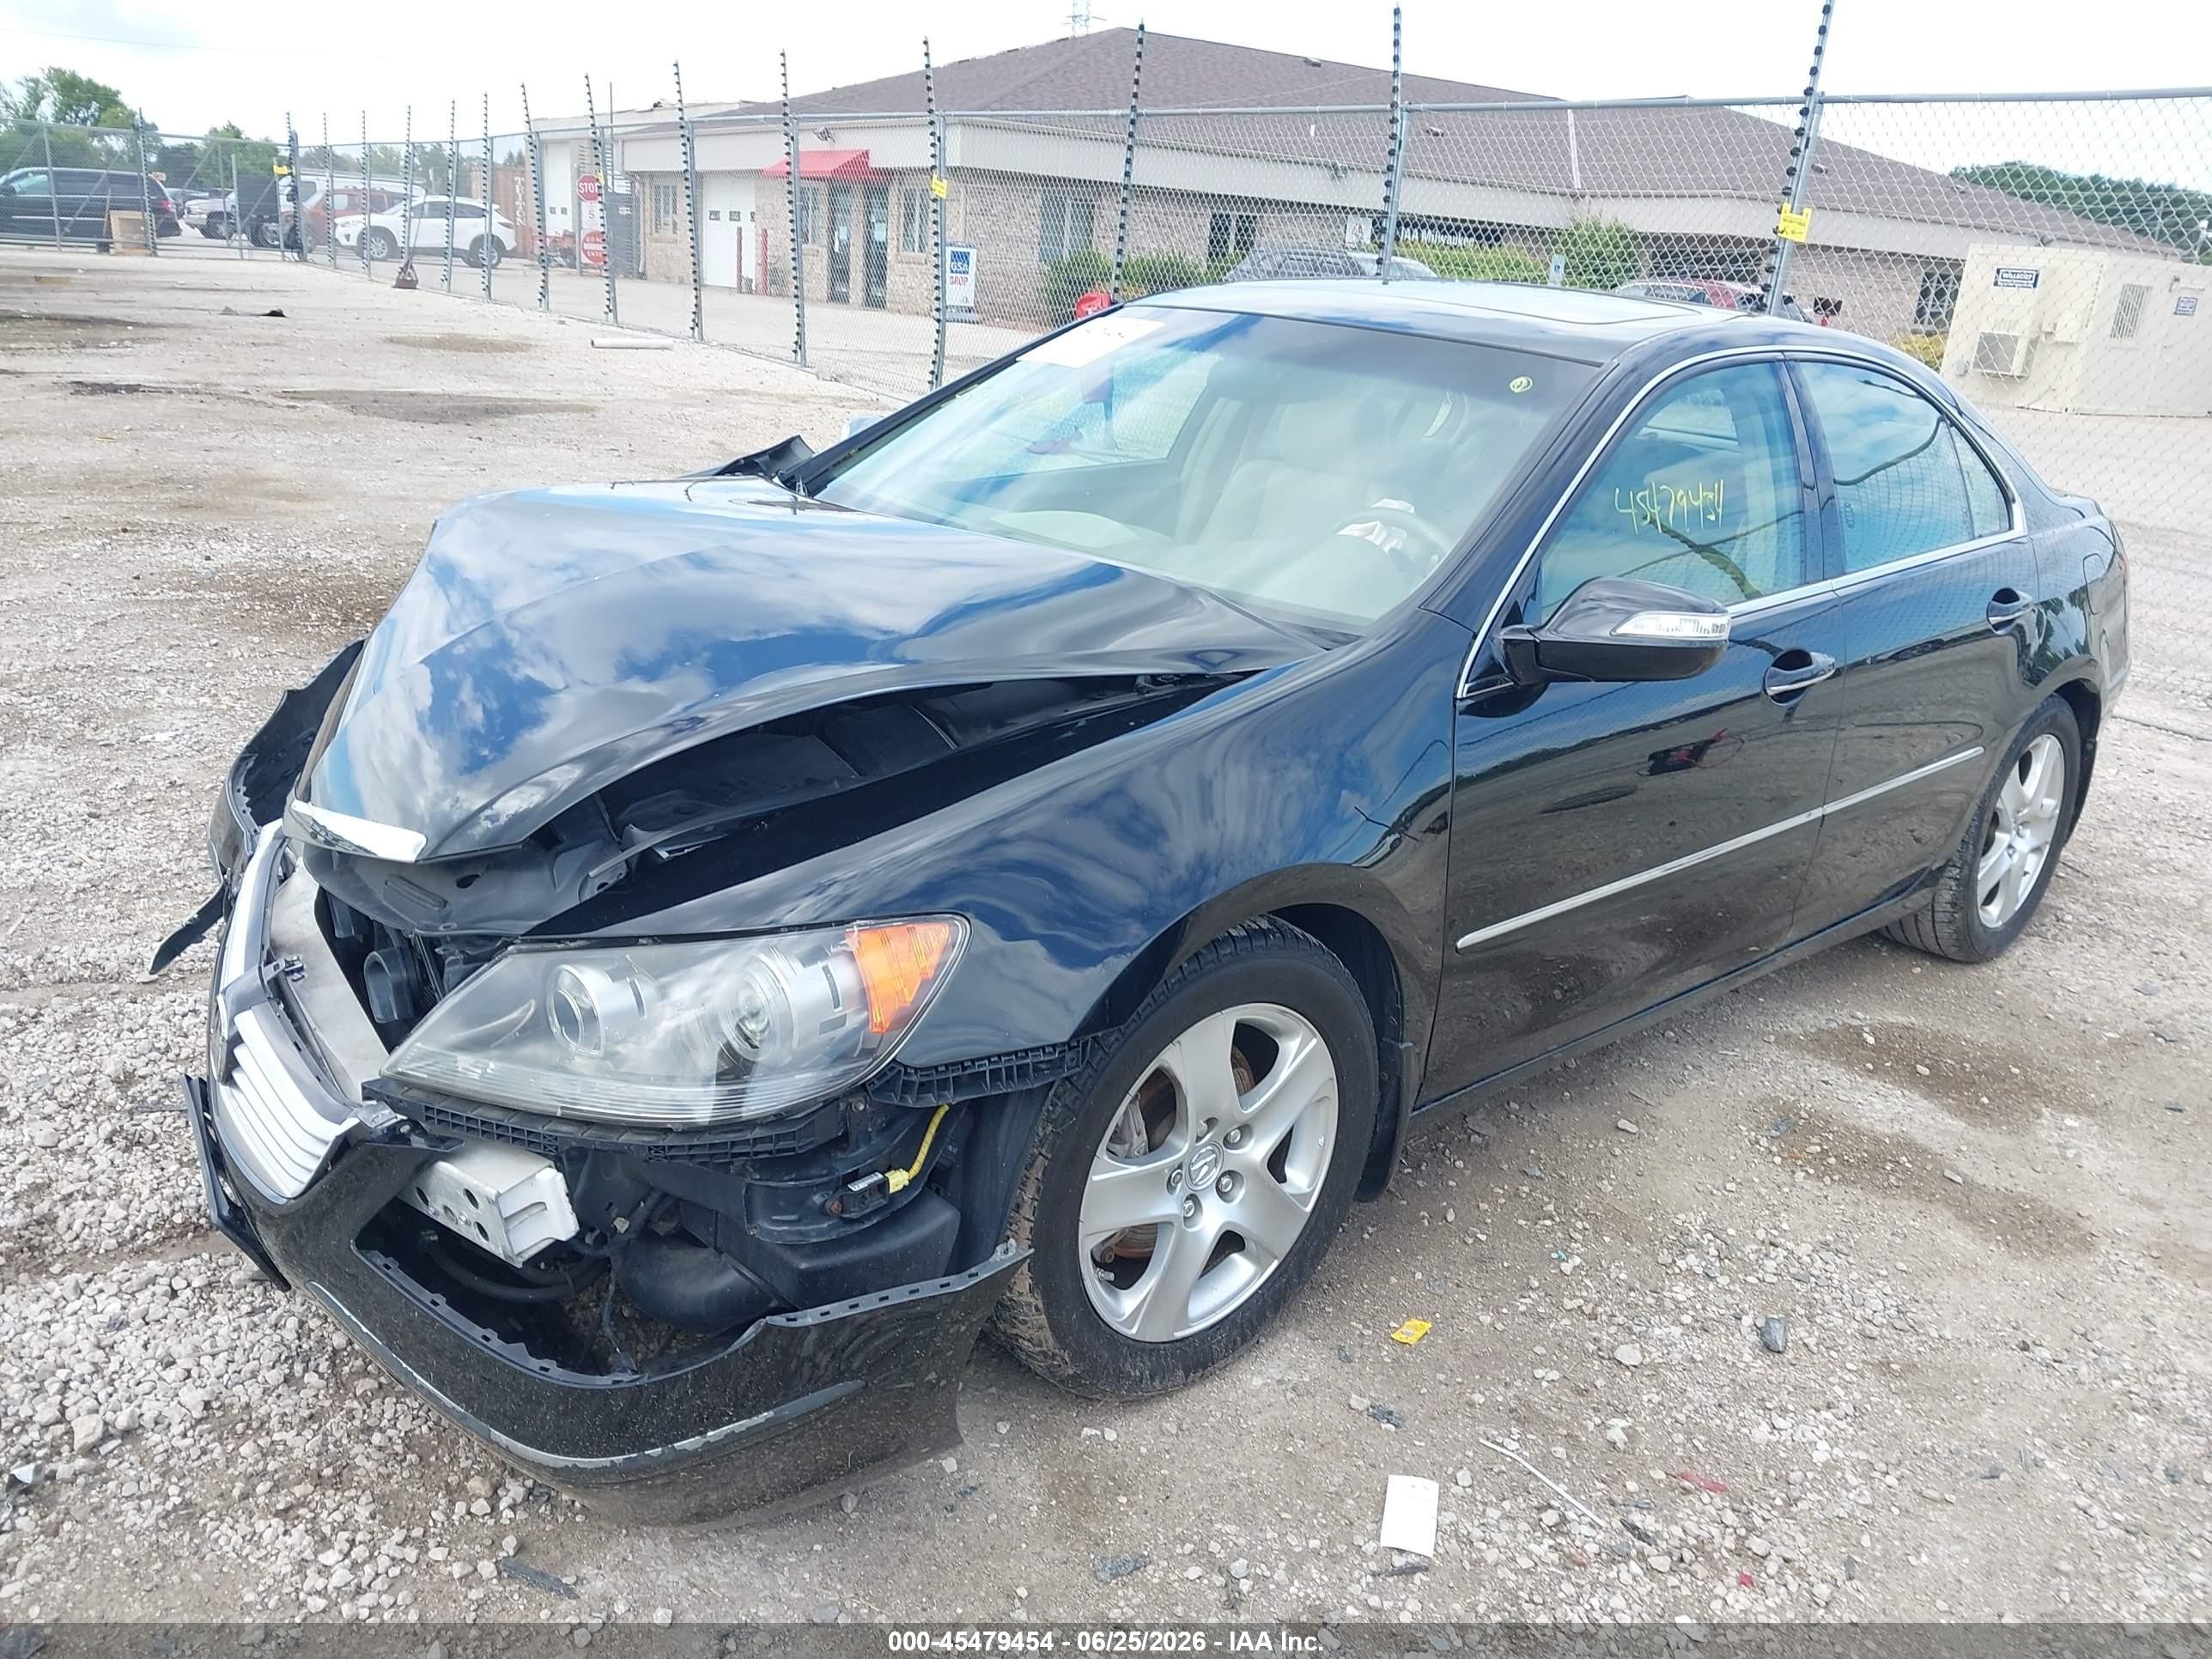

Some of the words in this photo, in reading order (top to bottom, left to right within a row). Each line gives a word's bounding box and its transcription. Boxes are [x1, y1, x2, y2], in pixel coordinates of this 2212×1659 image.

[1401, 227, 1419, 241] IAA
[1421, 228, 1475, 247] Milwaukee
[951, 261, 969, 271] GSA
